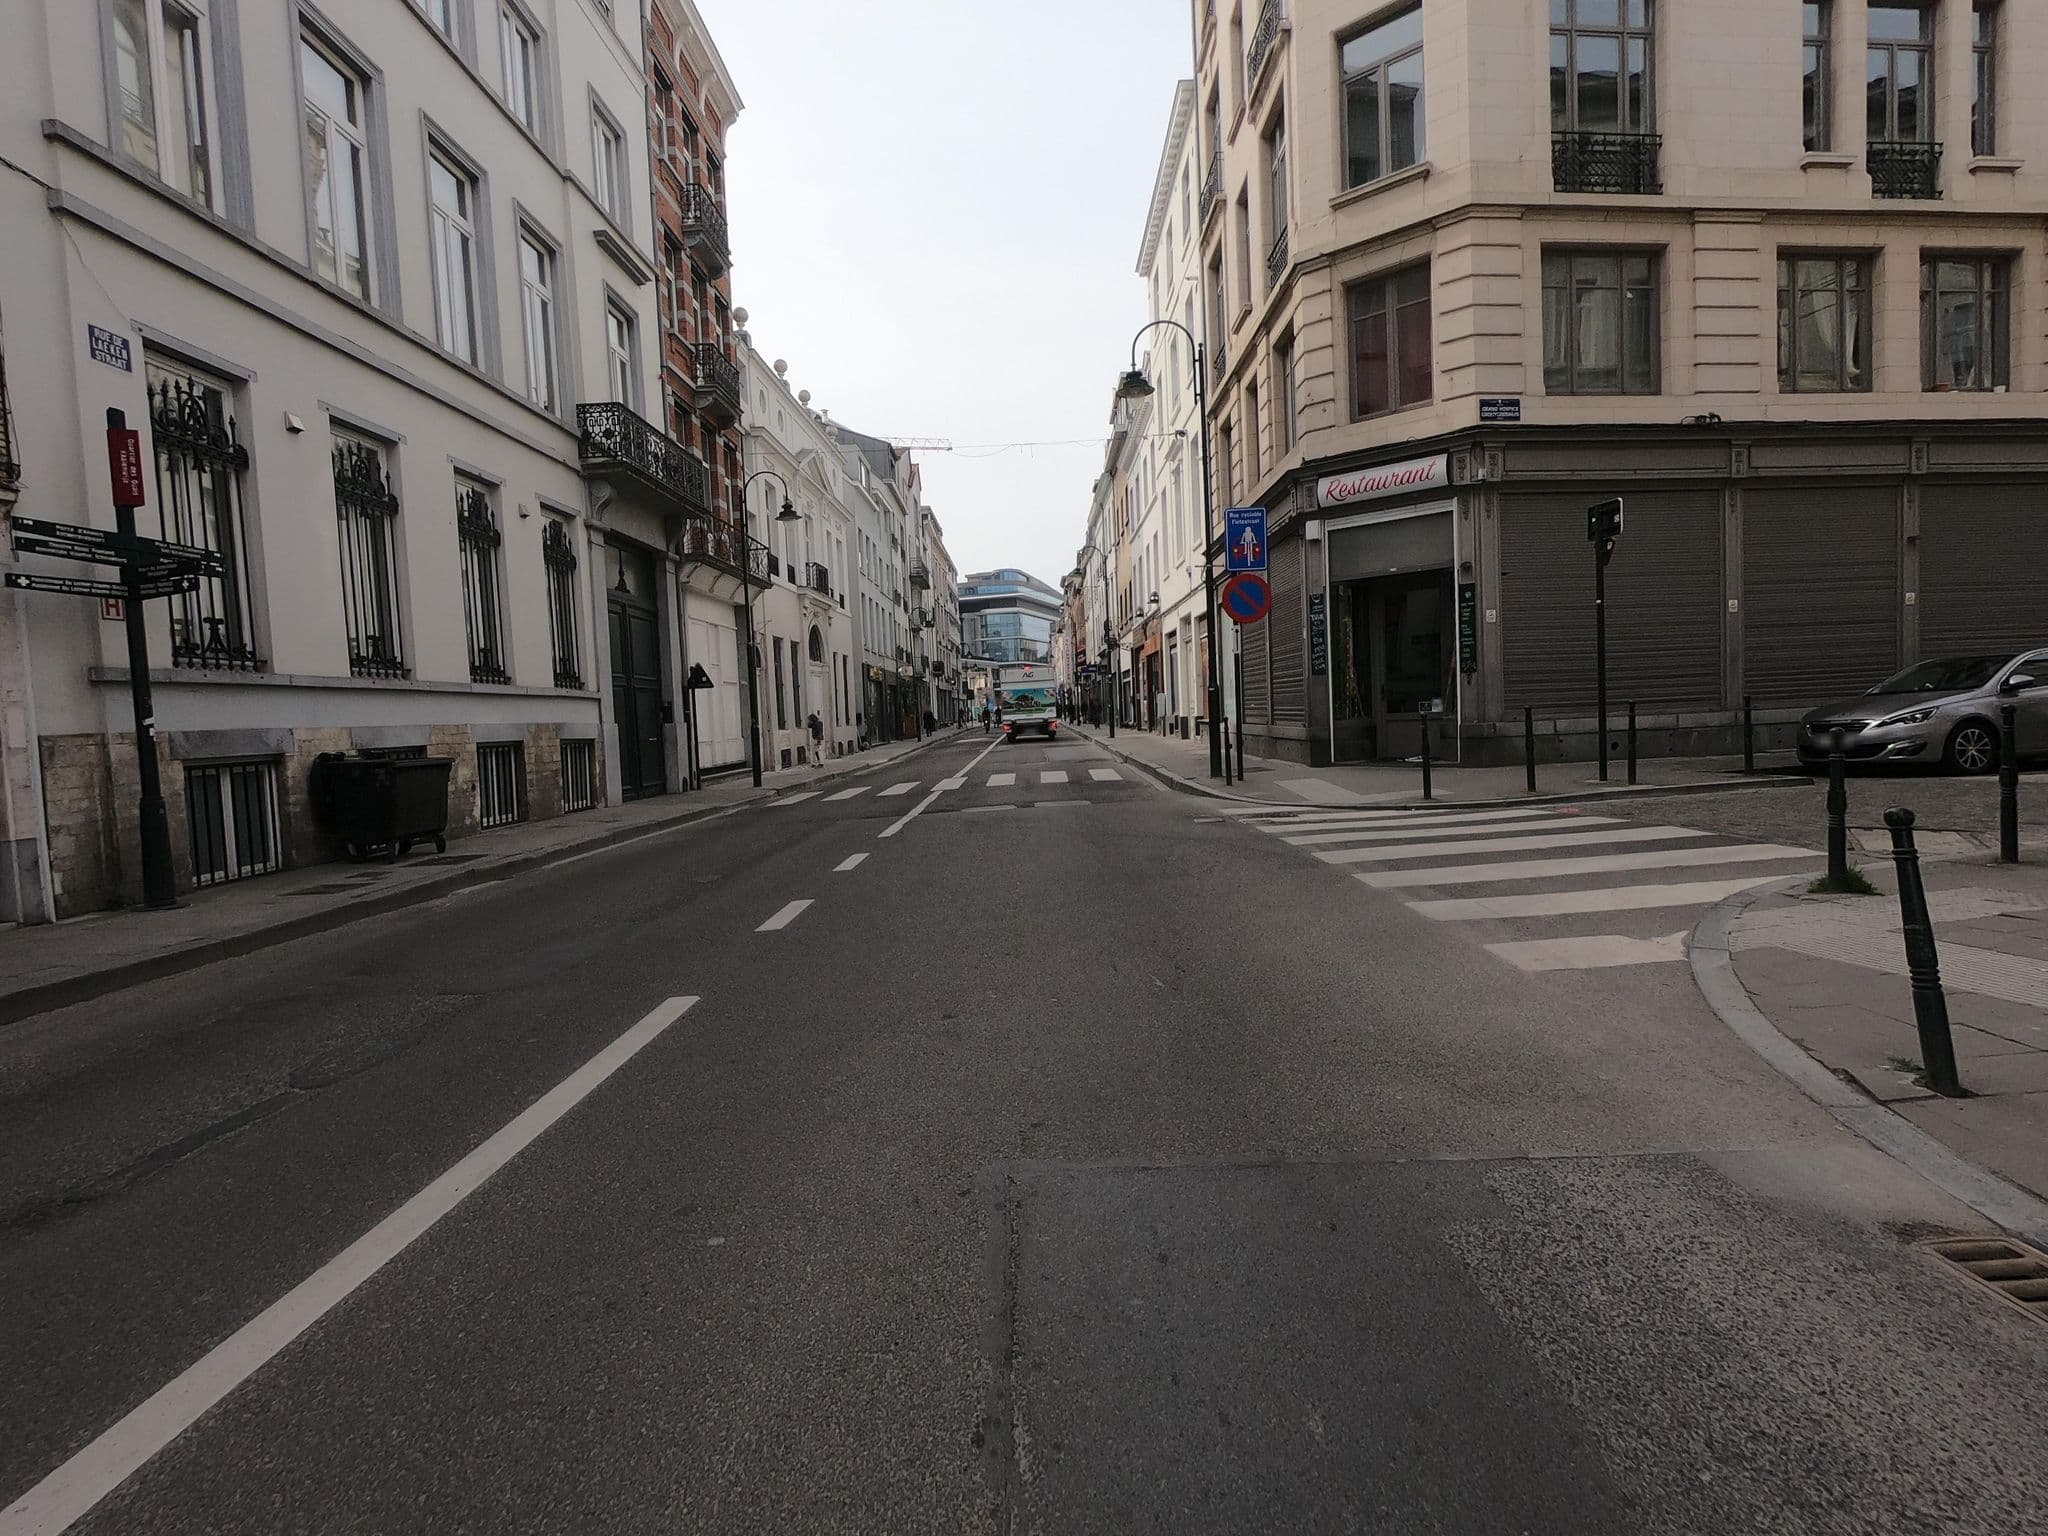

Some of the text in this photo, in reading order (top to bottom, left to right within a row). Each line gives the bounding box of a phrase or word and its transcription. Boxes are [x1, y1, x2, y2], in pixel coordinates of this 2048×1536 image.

[94, 328, 125, 348] RUE DE
[95, 350, 128, 370] STRAAT
[1325, 459, 1437, 502] Restaurant
[105, 599, 121, 617] H
